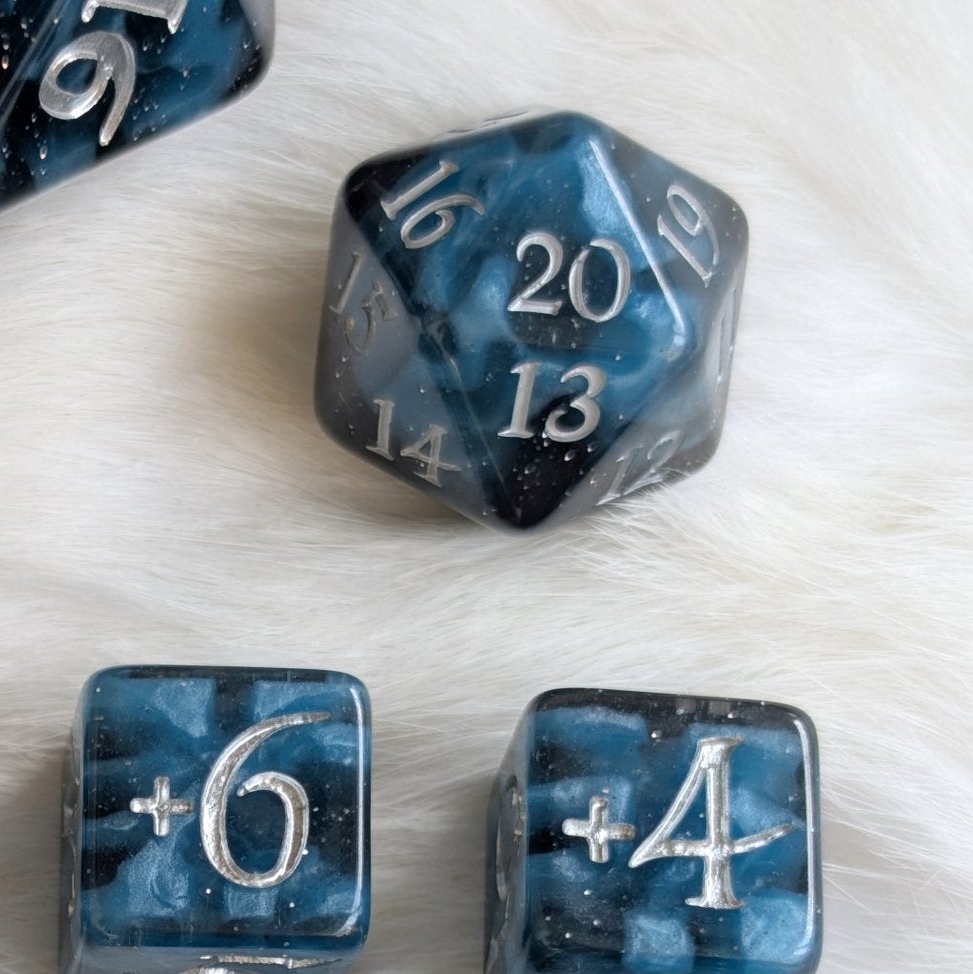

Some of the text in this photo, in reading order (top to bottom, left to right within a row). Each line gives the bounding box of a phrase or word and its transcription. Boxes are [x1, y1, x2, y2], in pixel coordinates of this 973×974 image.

[380, 159, 486, 250] 16
[657, 184, 719, 288] 19
[508, 231, 632, 323] 20
[365, 398, 462, 487] 14
[497, 362, 607, 443] 13
[129, 711, 332, 889] +6
[561, 736, 800, 910] +4
